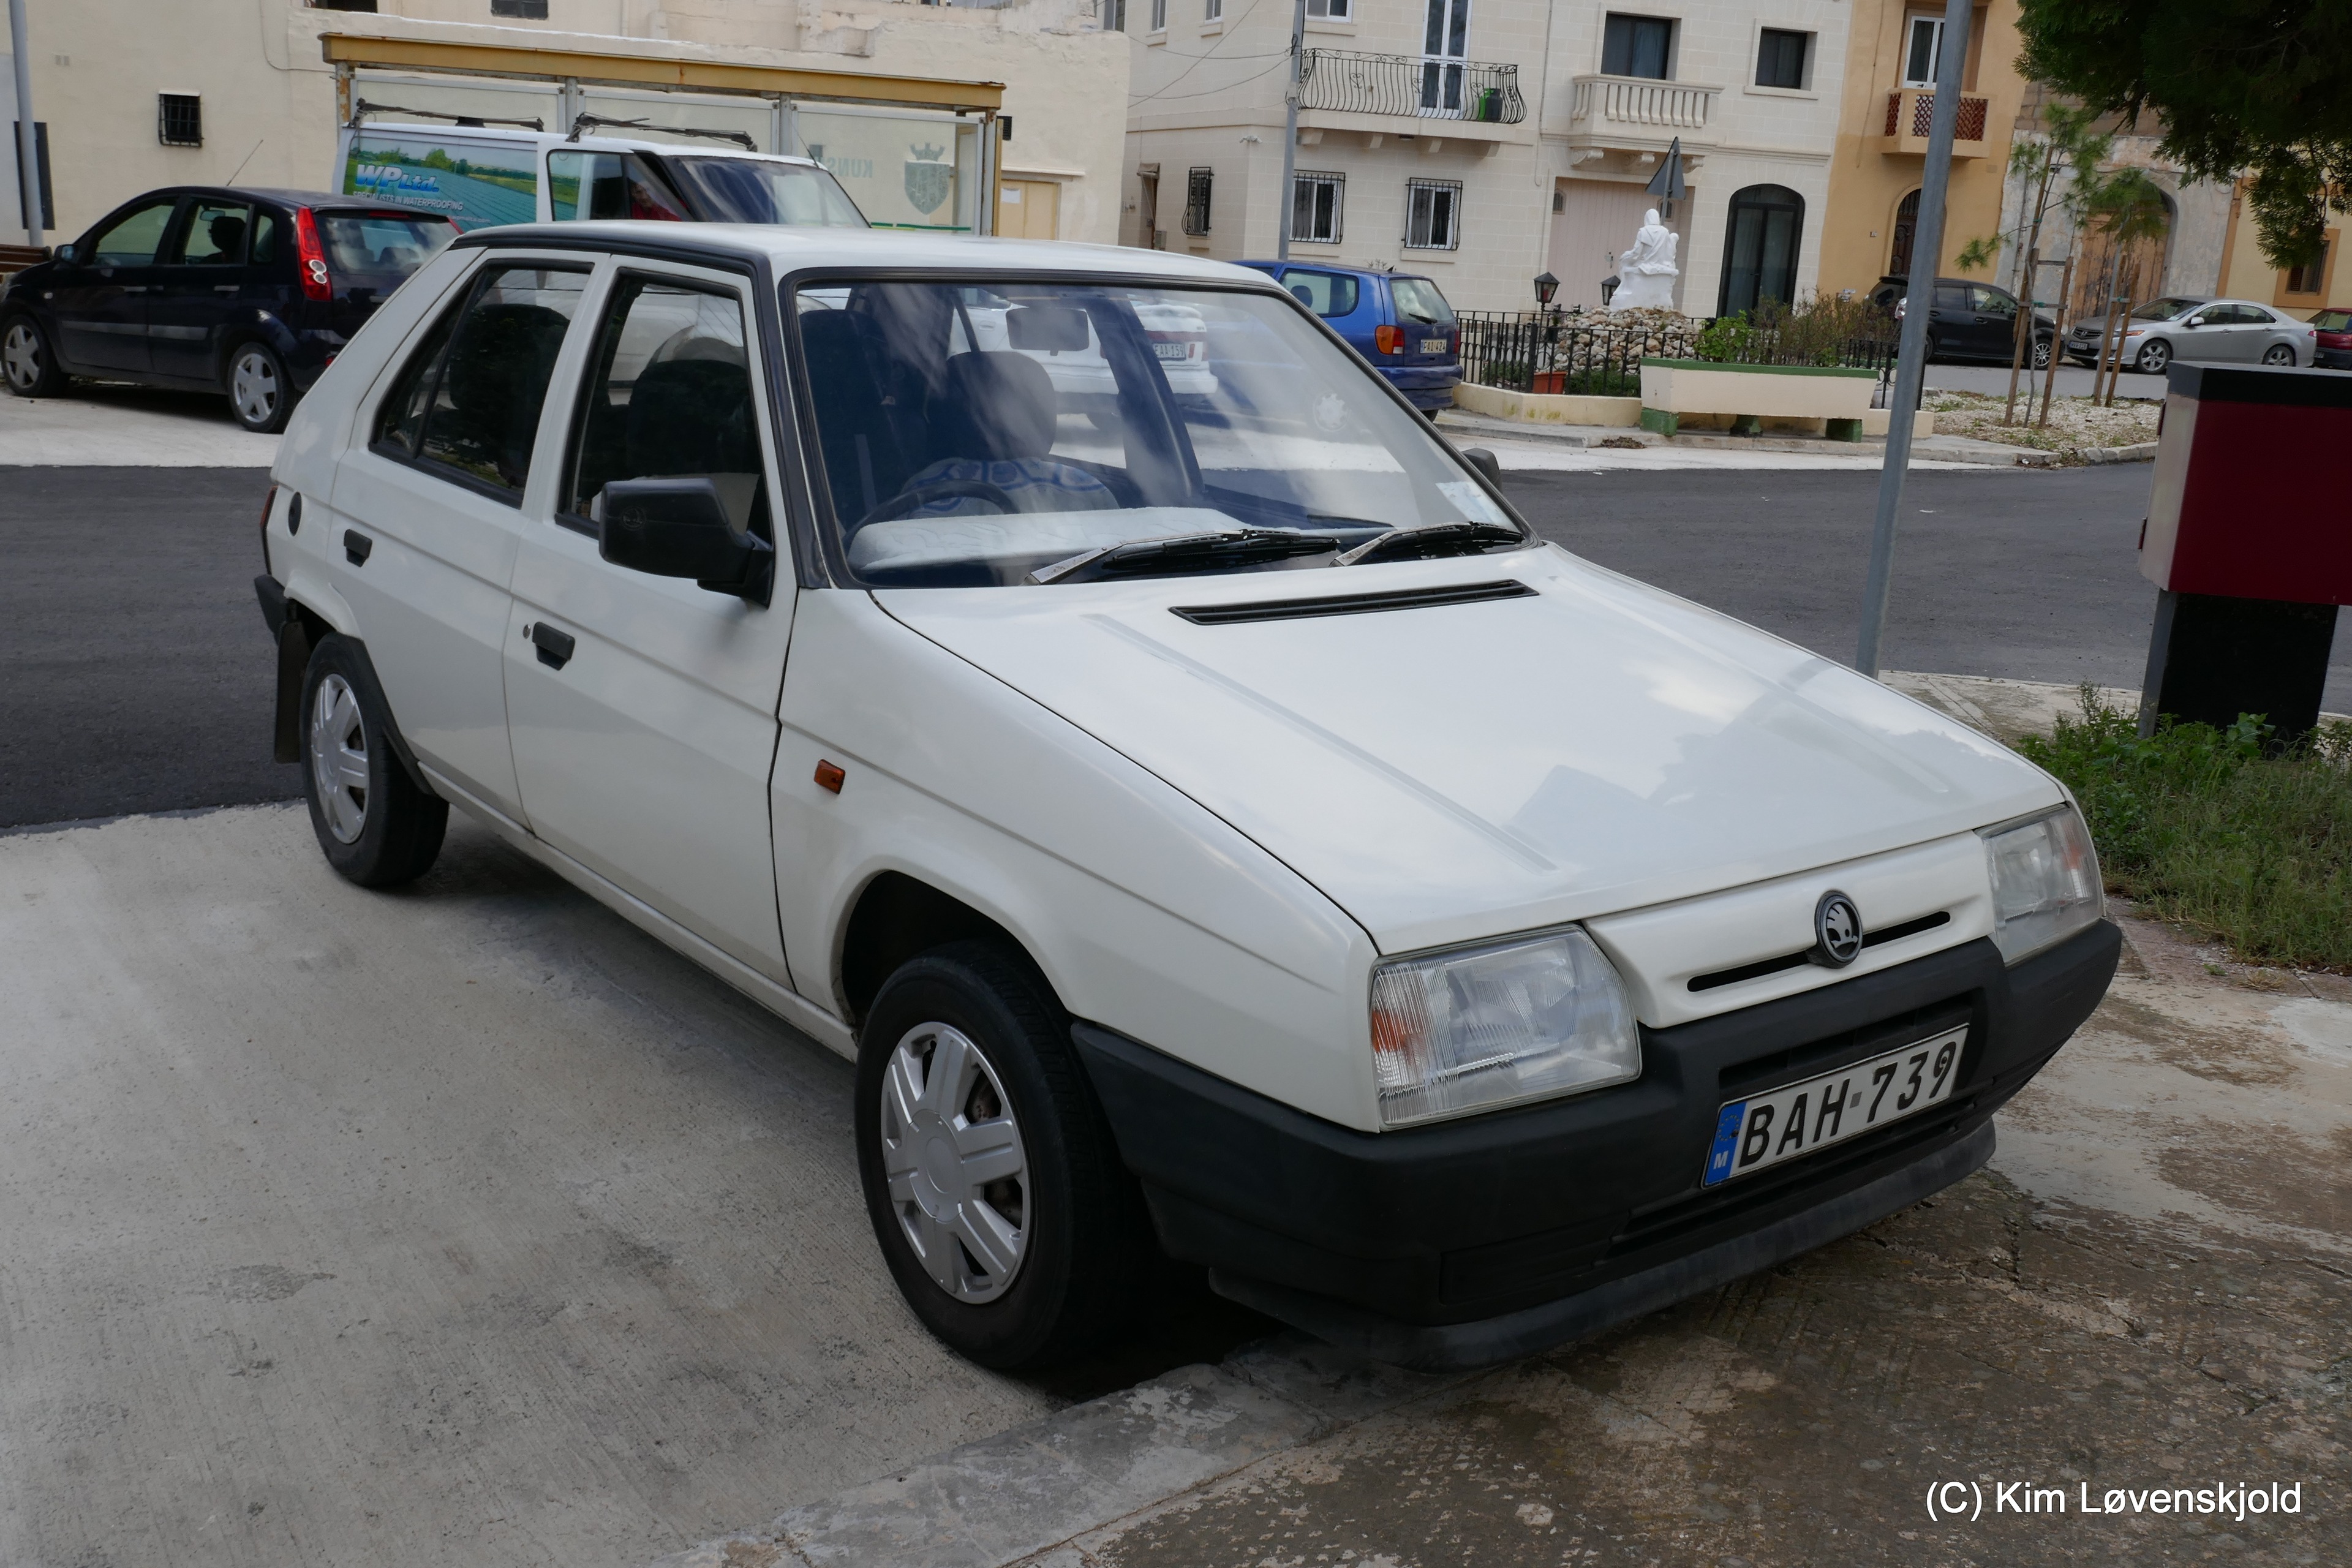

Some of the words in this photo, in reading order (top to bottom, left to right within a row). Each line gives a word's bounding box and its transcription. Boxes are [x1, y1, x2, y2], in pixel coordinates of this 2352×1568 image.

[353, 164, 402, 187] WP
[398, 174, 440, 192] Ltd.
[402, 197, 464, 211] WATERPROOFING
[1713, 1150, 1728, 1170] M
